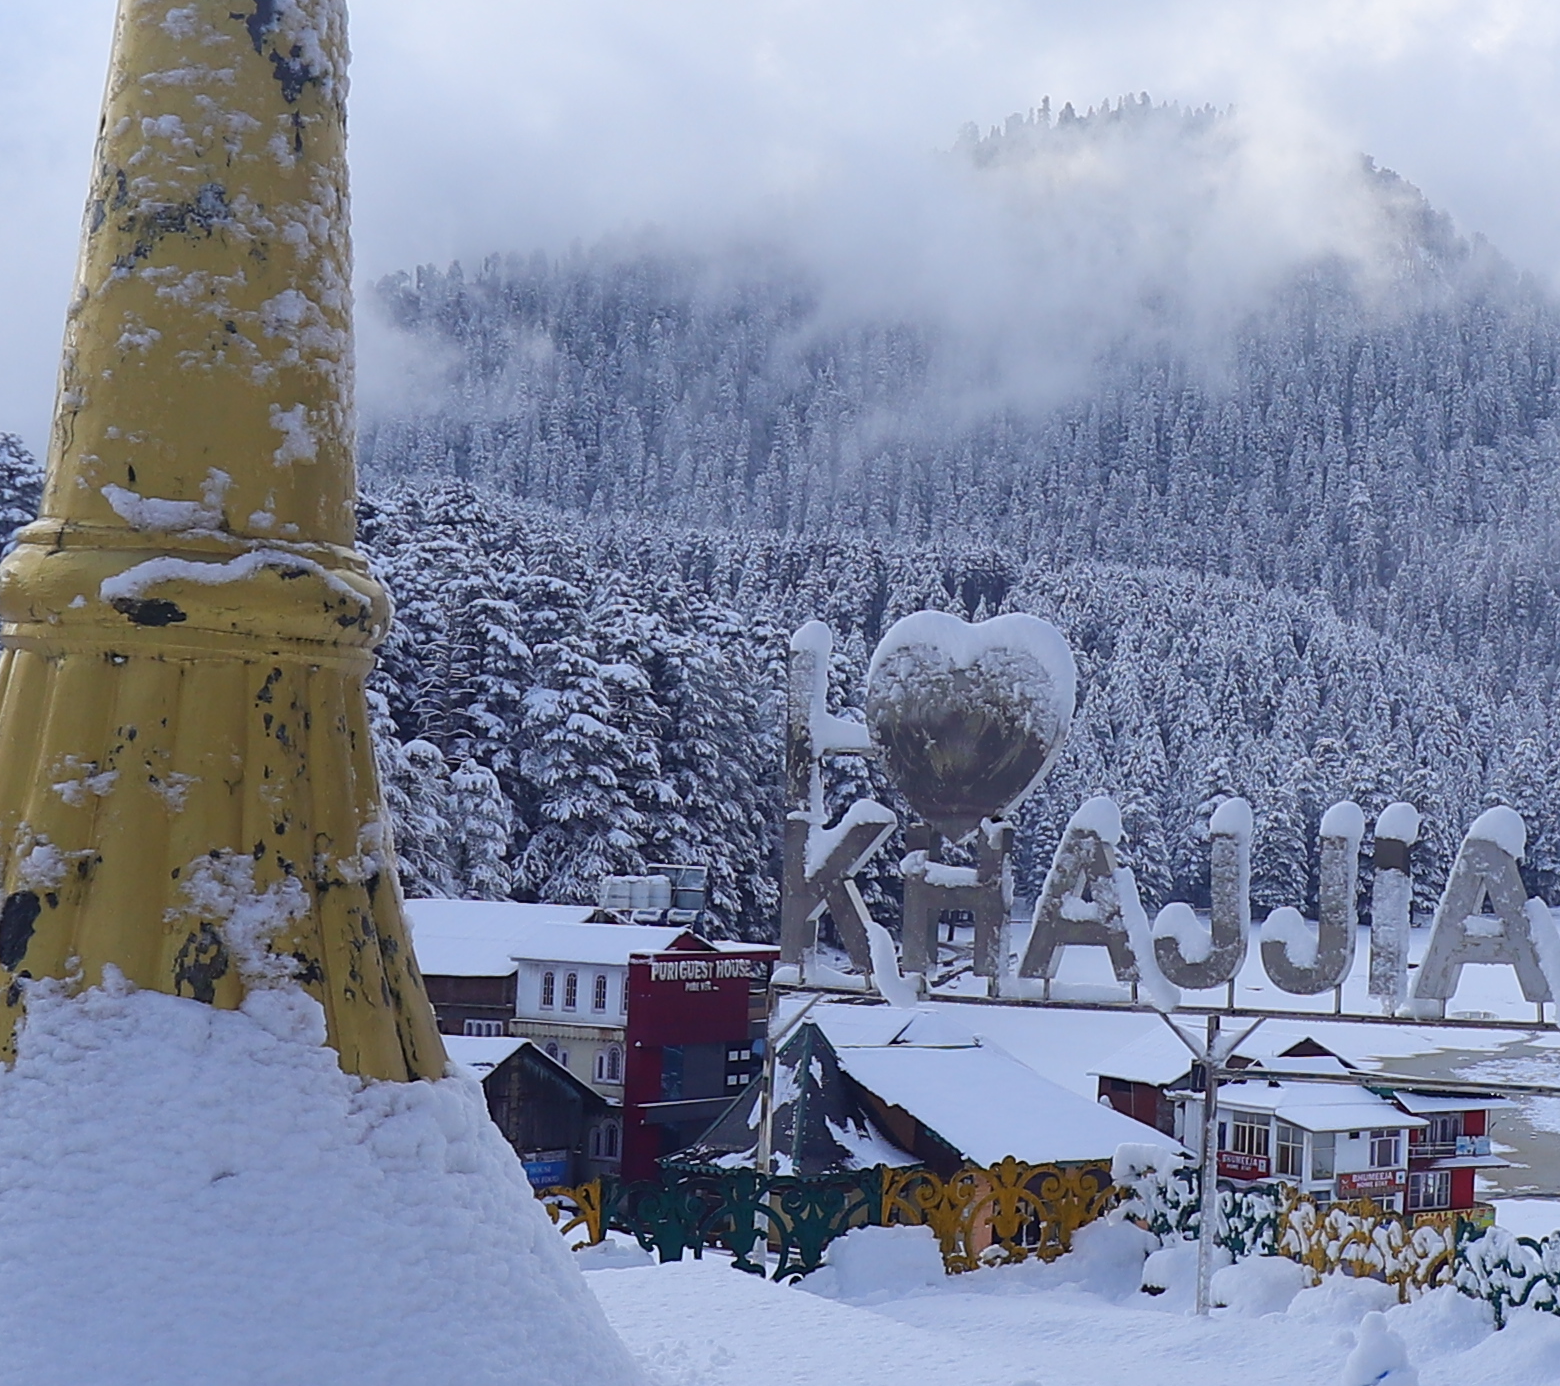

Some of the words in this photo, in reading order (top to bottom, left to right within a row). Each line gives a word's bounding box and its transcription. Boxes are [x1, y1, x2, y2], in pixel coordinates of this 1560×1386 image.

[651, 961, 678, 981] PURI
[679, 960, 714, 980] GUEST
[716, 959, 751, 978] HOUSE
[1351, 1171, 1393, 1183] BHUMEEJA
[1415, 1209, 1473, 1224] QATY
